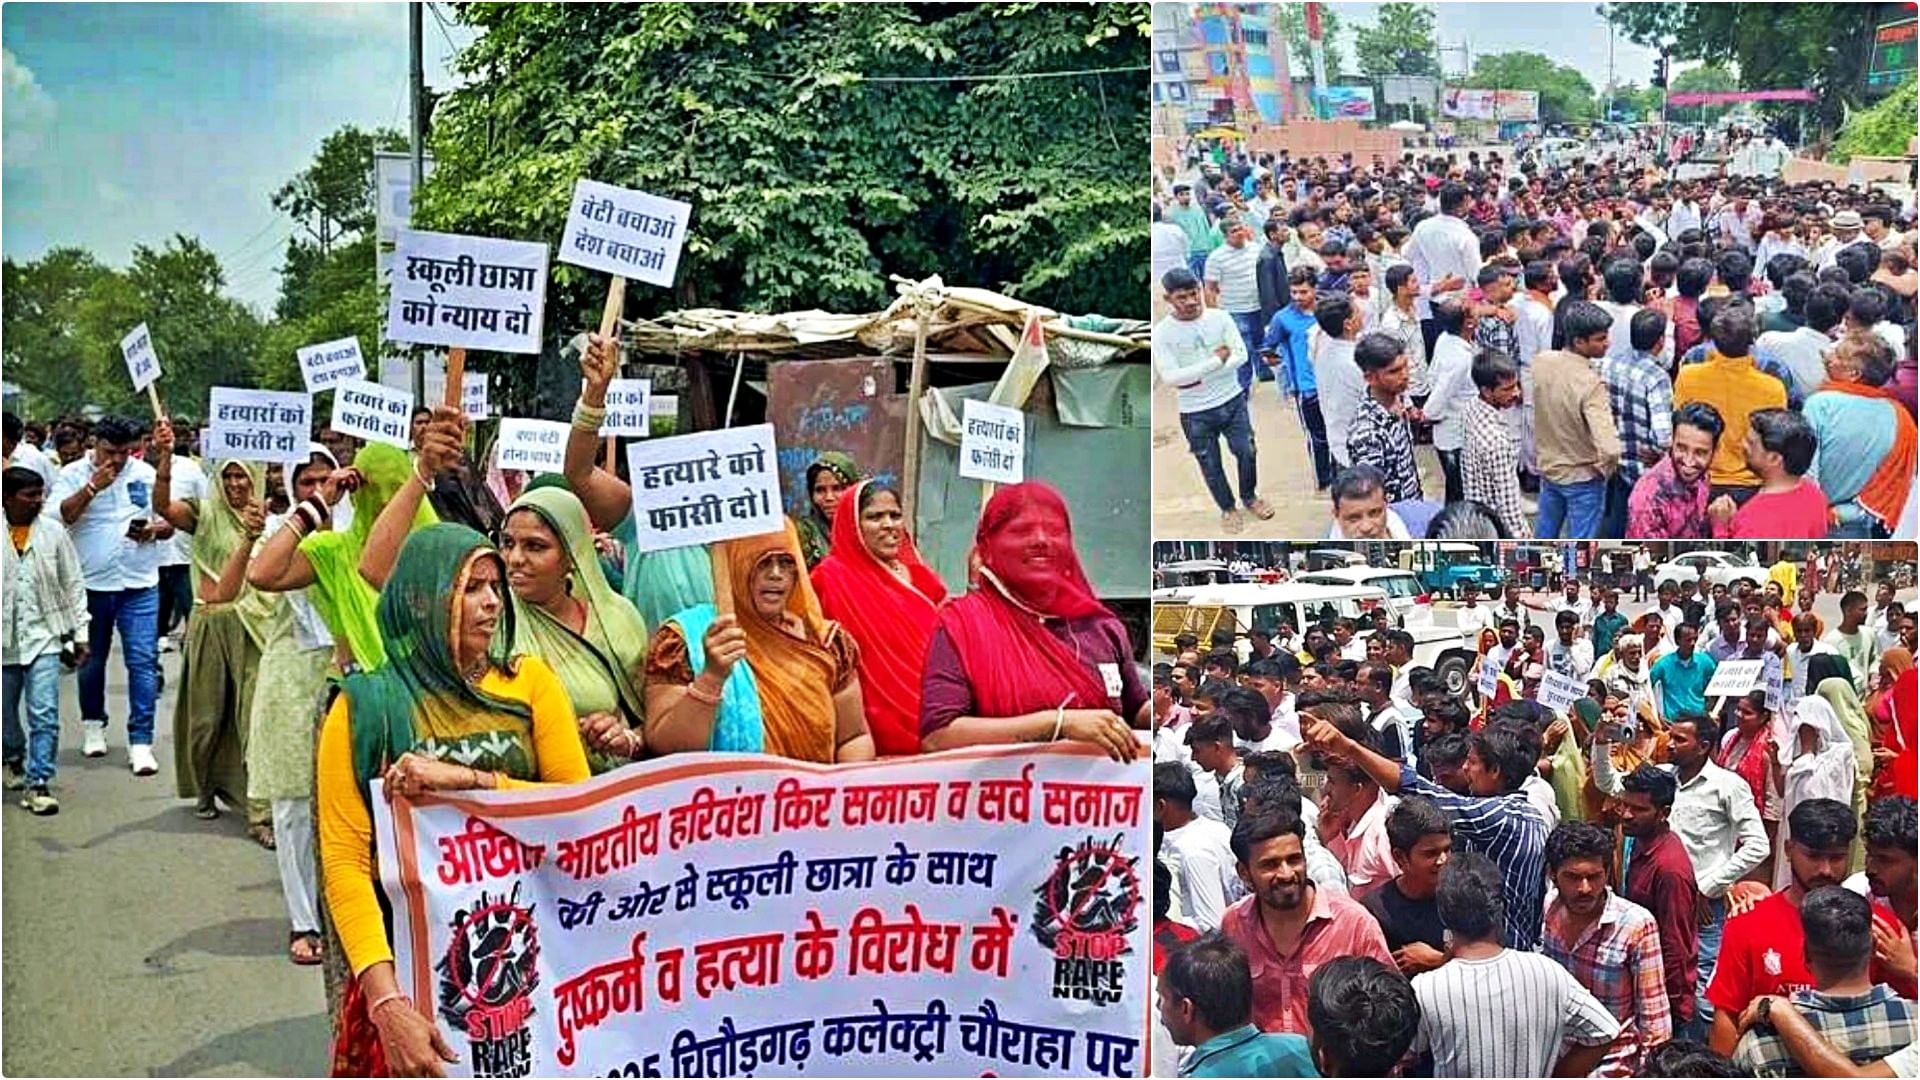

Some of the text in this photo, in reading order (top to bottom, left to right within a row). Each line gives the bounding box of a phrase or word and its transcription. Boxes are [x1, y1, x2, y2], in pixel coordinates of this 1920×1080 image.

[581, 194, 677, 239] बेटी बचाओ
[574, 227, 666, 271] देश बचाओ
[407, 254, 538, 293] स्कूली छात्रा
[402, 294, 532, 335] को न्याय दो
[218, 402, 305, 425] हत्यारों को
[342, 388, 408, 417] हत्यारे को
[625, 388, 643, 405] को
[225, 428, 295, 451] फांसी दो
[341, 410, 380, 432] फांसी
[1007, 422, 1020, 444] को
[640, 449, 722, 489] हत्यारे
[726, 442, 766, 476] को
[971, 445, 1015, 471] फांसी दो
[648, 493, 724, 531] फांसी
[555, 805, 662, 880] भारतीय
[668, 786, 766, 850] हरिवंश
[772, 778, 836, 833] किर
[842, 783, 940, 827] समाज
[947, 781, 971, 821] व
[977, 763, 1035, 823] सर्व
[1042, 781, 1143, 827] समाज
[558, 841, 998, 931] की ओर से स्कूली छात्रा के साथ
[1054, 931, 1126, 960] STOP
[554, 904, 1018, 1066] दुष्कर्म व हत्या के विरोध में
[1053, 960, 1124, 990] RAPE
[1052, 987, 1122, 1003] NOW
[466, 997, 531, 1042] STOP
[823, 998, 952, 1063] कलेक्ट्री
[959, 998, 1076, 1070] चौराहा
[1086, 1032, 1140, 1078] पर
[471, 1026, 532, 1074] RAPE
